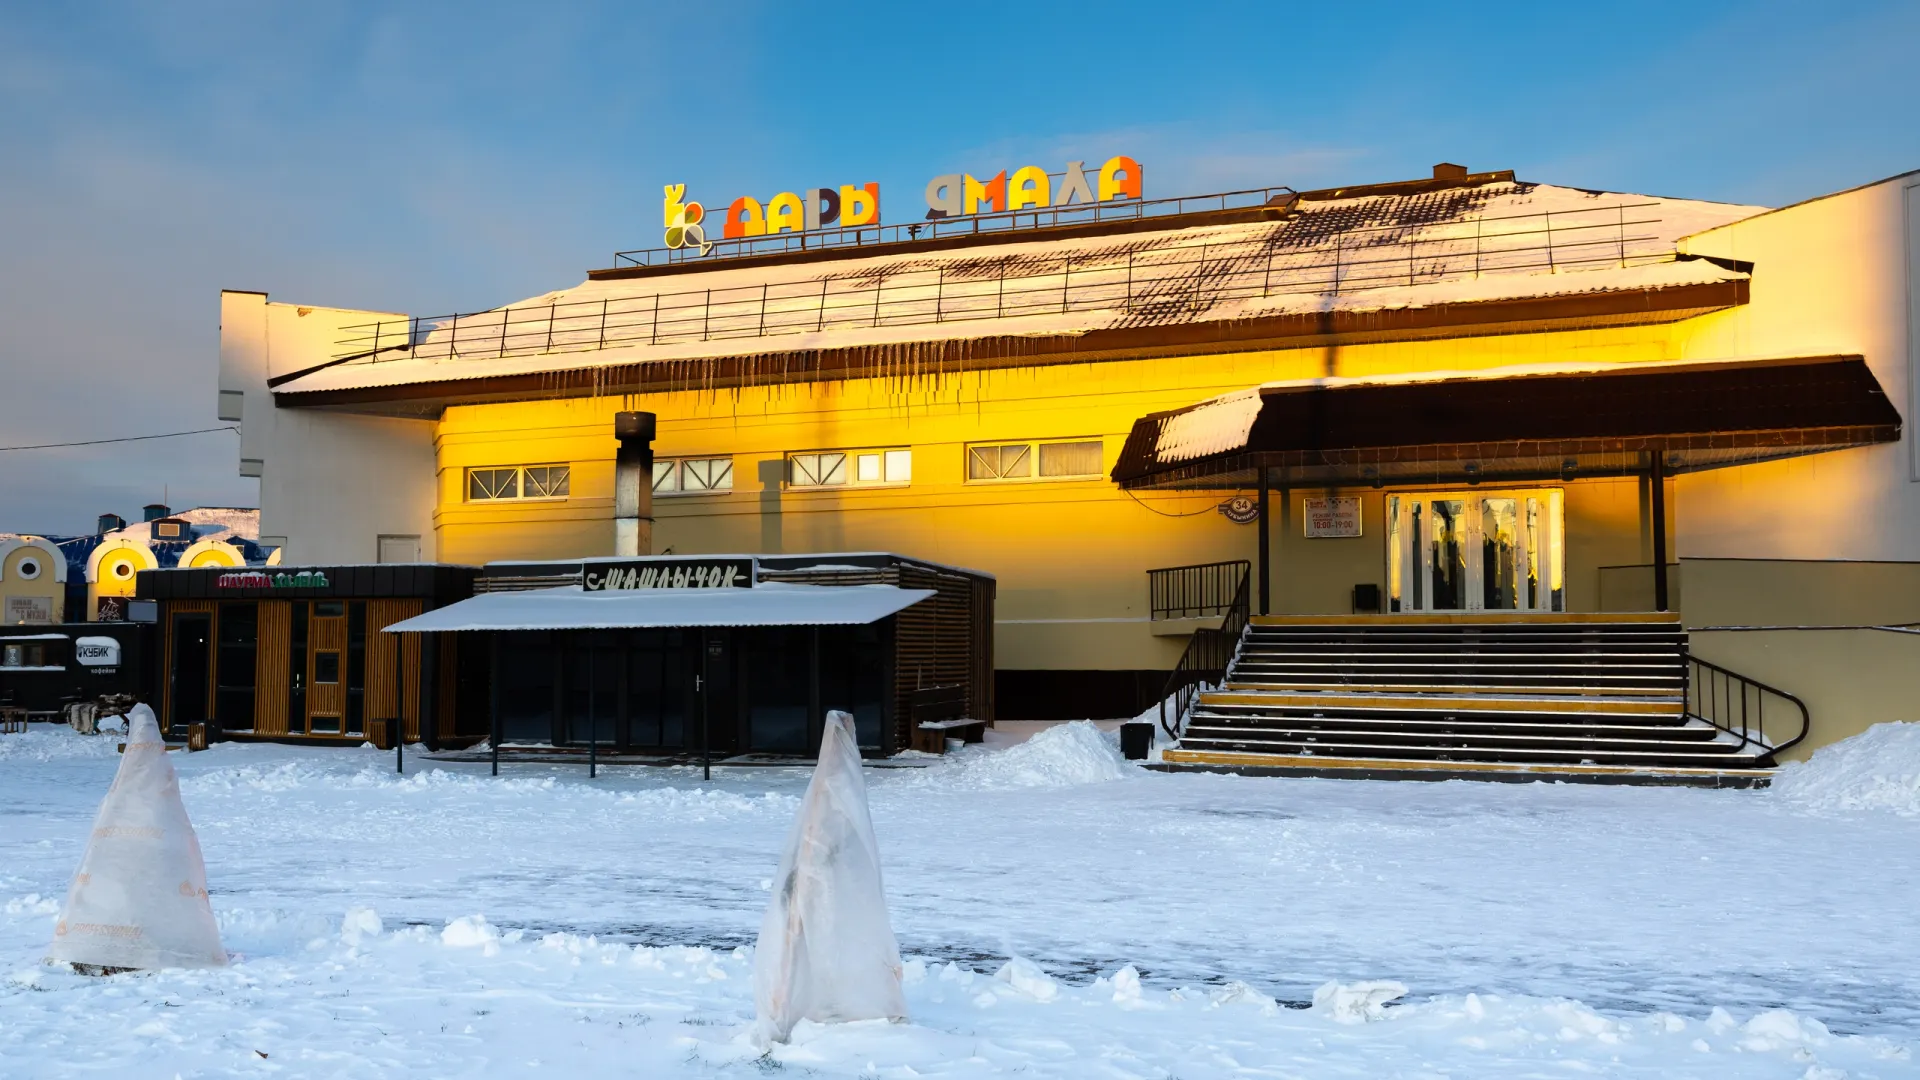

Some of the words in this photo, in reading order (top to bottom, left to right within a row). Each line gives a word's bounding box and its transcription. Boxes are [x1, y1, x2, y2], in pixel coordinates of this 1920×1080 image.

[723, 182, 879, 239] ДАРЫ
[925, 155, 1143, 219] ЯМАЛА
[1235, 500, 1248, 510] 34
[82, 646, 109, 658] КУБИК
